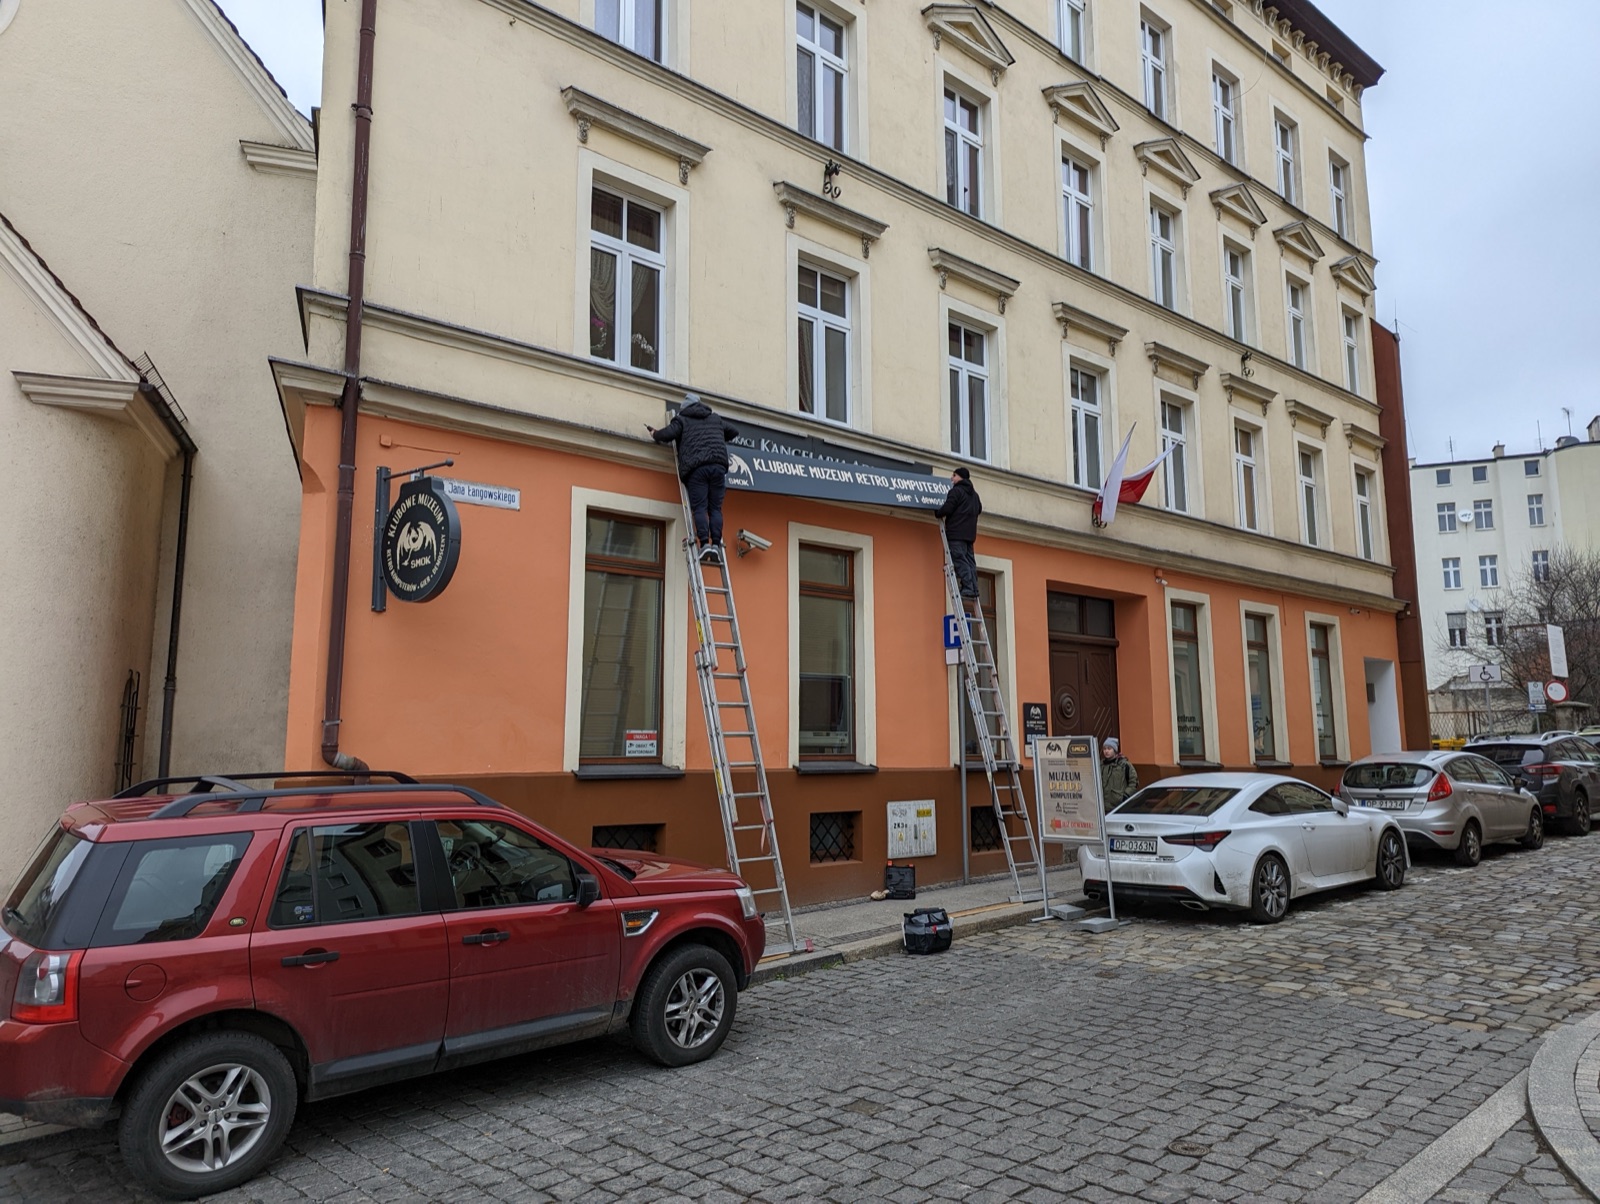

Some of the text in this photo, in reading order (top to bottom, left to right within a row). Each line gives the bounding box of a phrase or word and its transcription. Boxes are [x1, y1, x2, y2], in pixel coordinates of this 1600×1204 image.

[753, 457, 808, 477] KLUBOWE
[808, 465, 854, 483] MUZEUM
[728, 477, 749, 487] SMOK
[448, 482, 516, 504] Jana Łangowskiego
[896, 492, 912, 503] gier
[914, 494, 920, 503] i
[387, 492, 445, 538] KLUBOWE MUZEUM
[410, 554, 432, 570] SMOK
[431, 534, 446, 576] DEMOSCENY
[1048, 771, 1081, 781] MUZEUM
[1128, 840, 1155, 852] 0363N
